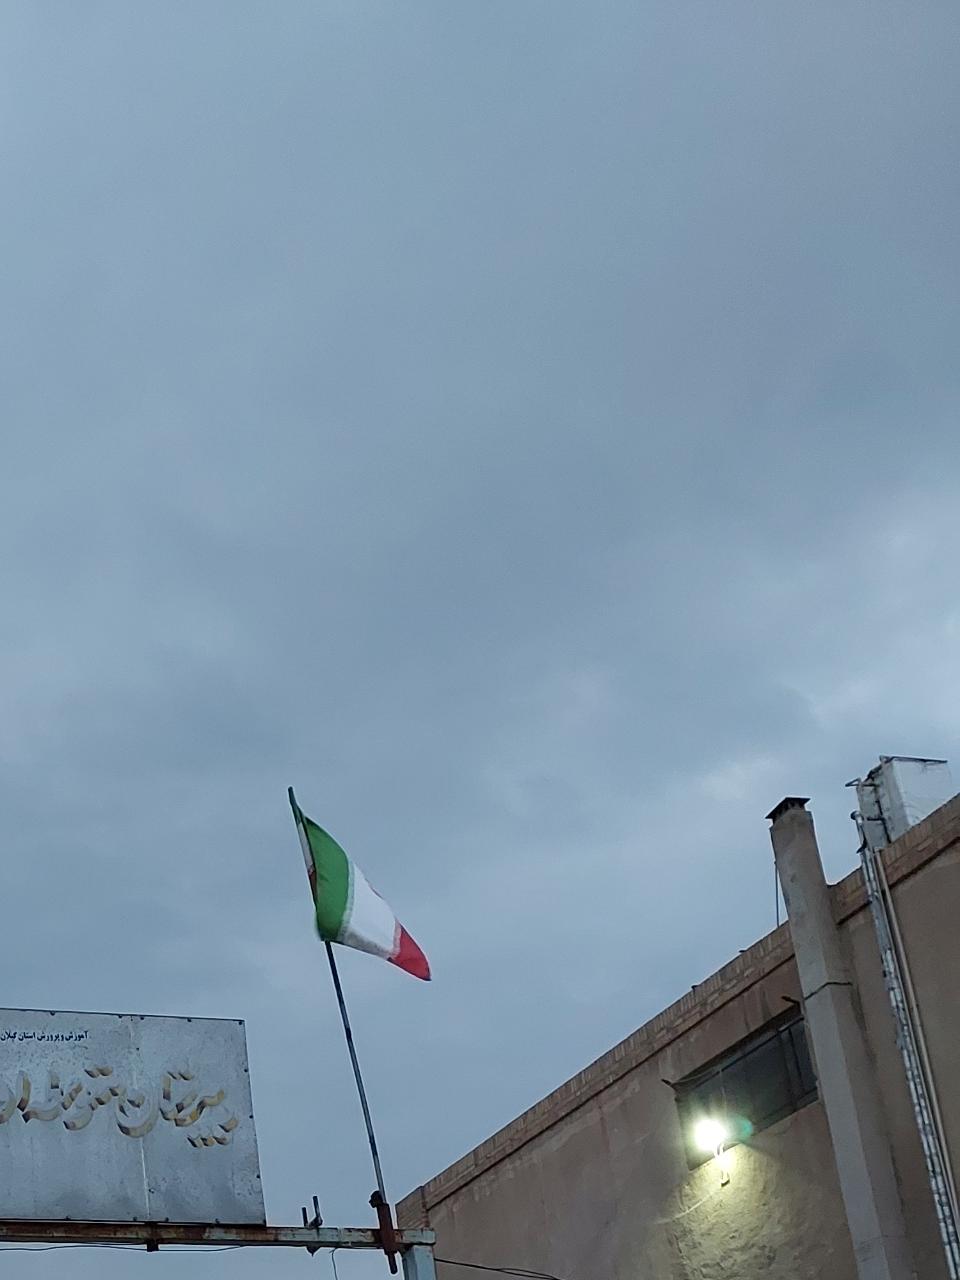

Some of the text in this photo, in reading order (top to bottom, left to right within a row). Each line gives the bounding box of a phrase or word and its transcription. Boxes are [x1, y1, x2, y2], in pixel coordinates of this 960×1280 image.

[0, 1030, 18, 1043] گیلان
[18, 1031, 36, 1042] استان
[64, 1030, 89, 1042] آموزش
